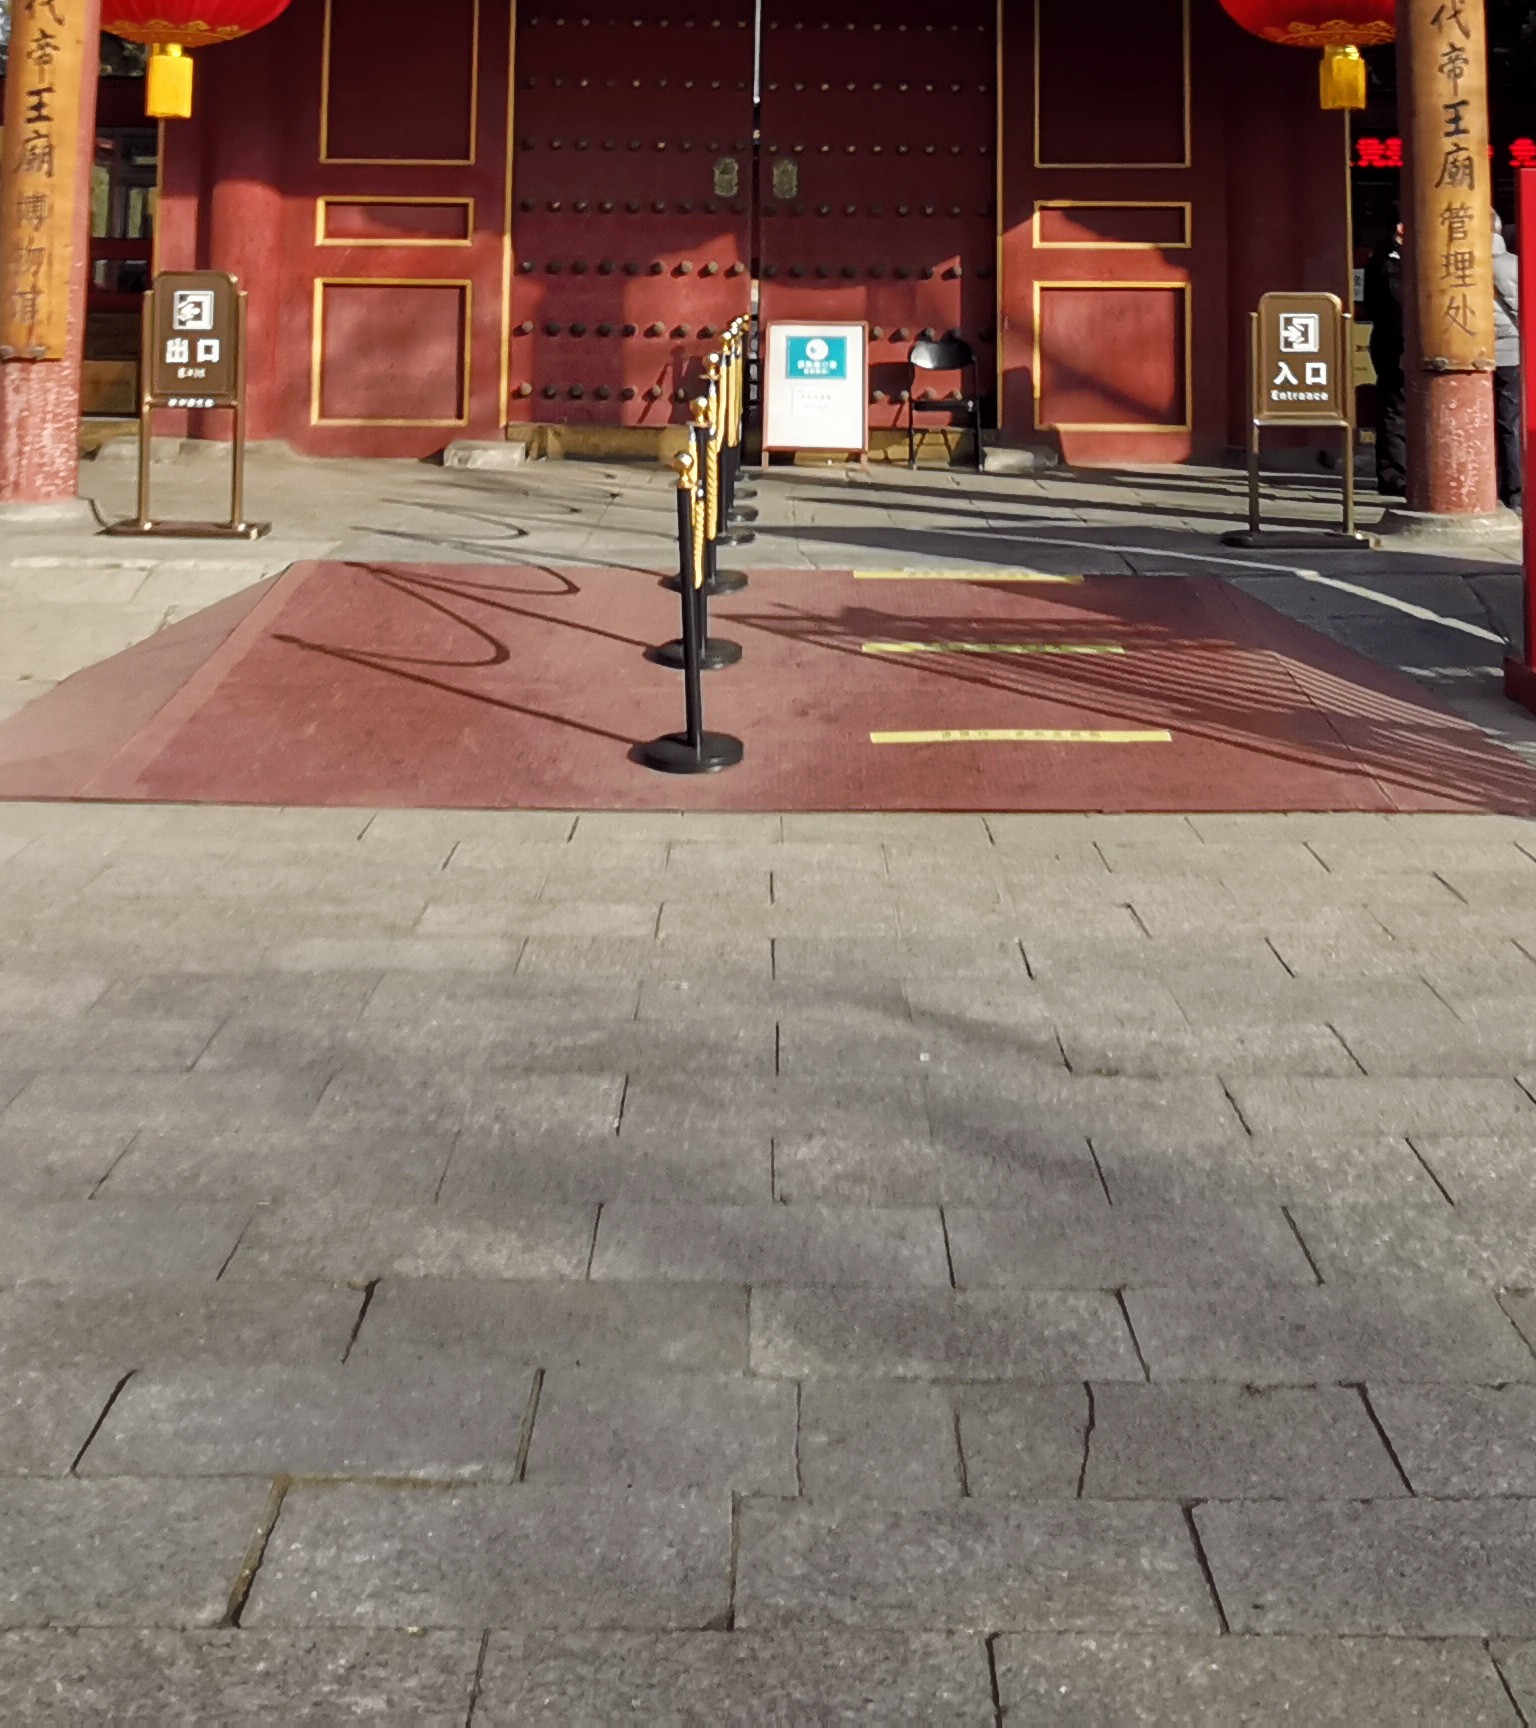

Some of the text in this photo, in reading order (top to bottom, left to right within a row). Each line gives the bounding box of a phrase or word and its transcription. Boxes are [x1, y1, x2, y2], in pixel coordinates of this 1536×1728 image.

[166, 338, 220, 363] 出口
[1273, 362, 1328, 385] 入口
[1271, 390, 1329, 401] Entrance
